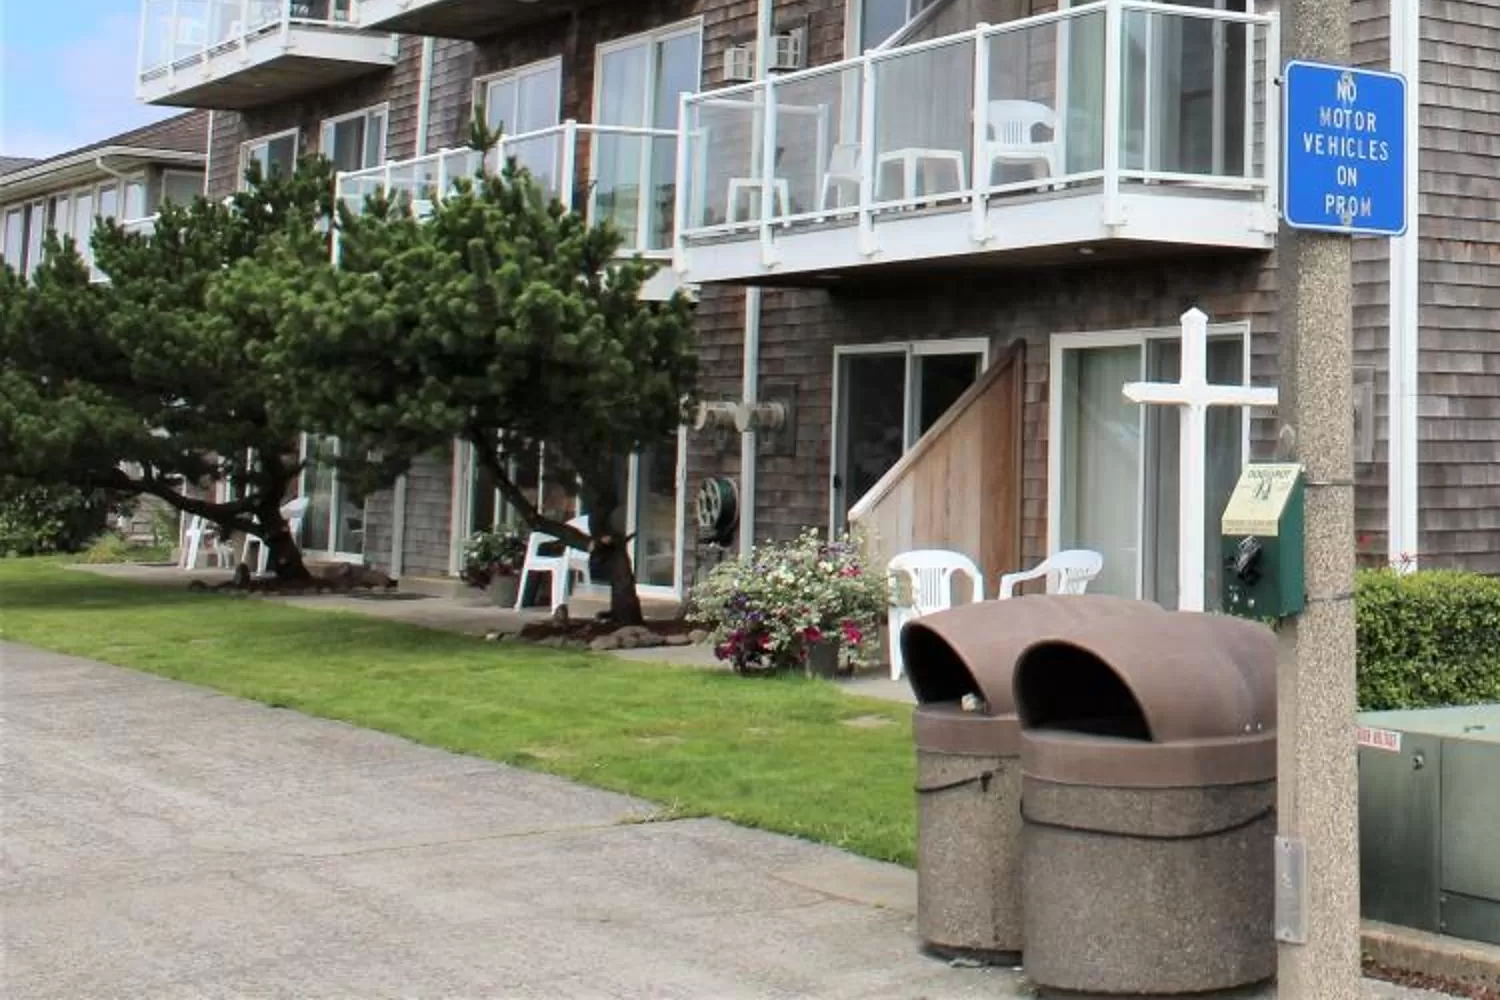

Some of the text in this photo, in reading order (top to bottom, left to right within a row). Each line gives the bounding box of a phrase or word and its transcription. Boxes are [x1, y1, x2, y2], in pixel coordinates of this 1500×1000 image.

[1336, 79, 1357, 103] NO
[1320, 106, 1377, 132] MOTOR
[1303, 131, 1389, 161] VEHICLES
[1336, 165, 1357, 187] ON
[1325, 193, 1372, 217] PROM
